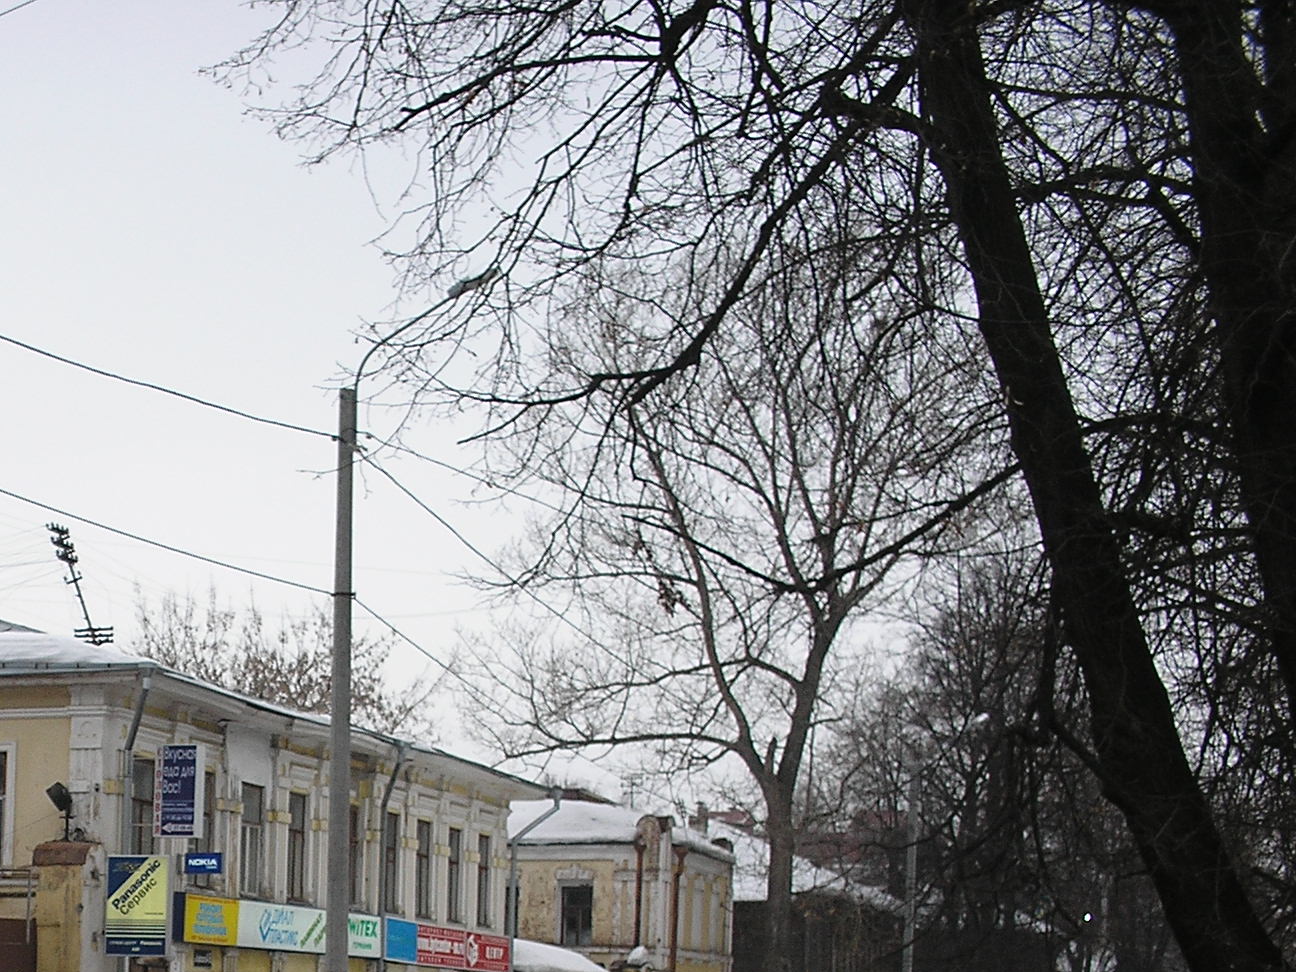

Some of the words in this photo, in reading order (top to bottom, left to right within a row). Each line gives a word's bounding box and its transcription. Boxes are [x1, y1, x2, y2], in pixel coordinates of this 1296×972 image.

[188, 858, 218, 866] NOKIA
[111, 859, 161, 910] Panasonic
[119, 878, 158, 915] Сервис
